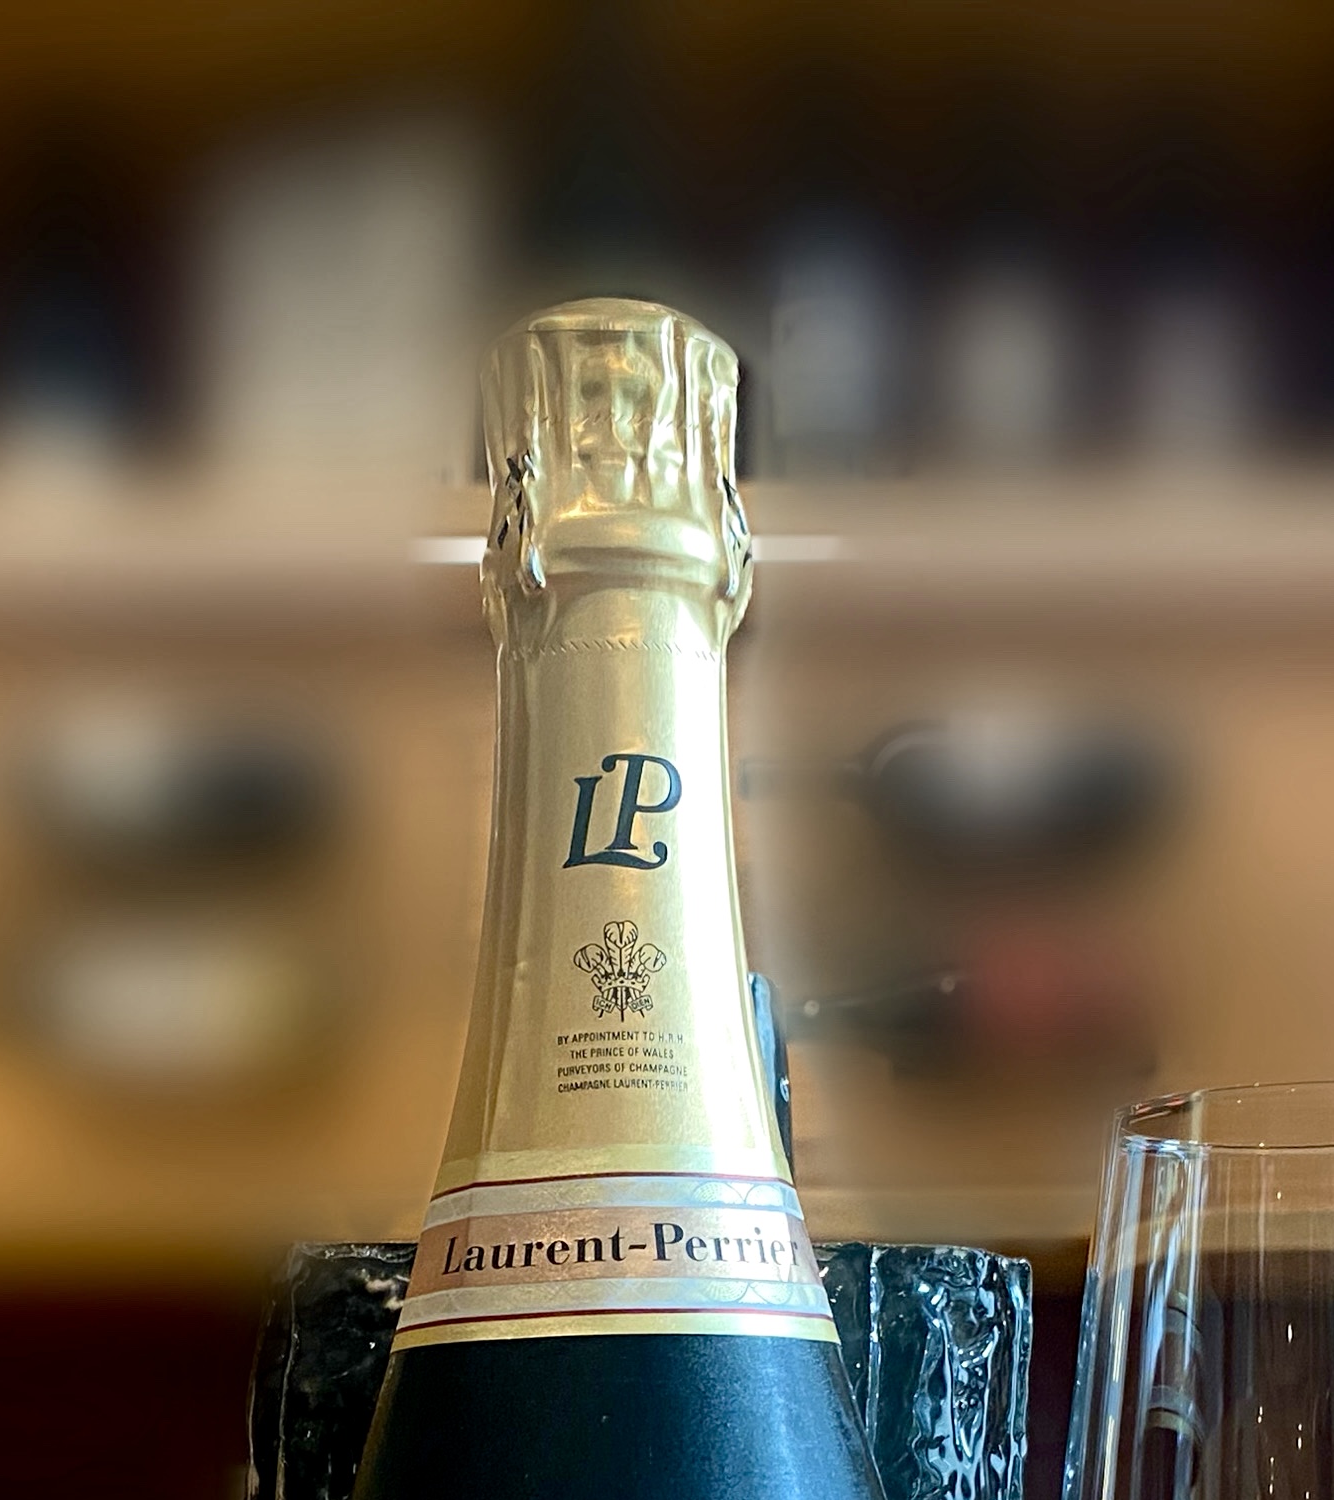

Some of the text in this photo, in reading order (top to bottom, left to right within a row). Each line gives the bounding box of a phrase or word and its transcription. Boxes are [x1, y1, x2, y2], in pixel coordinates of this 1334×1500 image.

[557, 1036, 569, 1046] BY
[571, 1031, 639, 1043] APPOINTMENT
[643, 1031, 655, 1042] TO
[570, 1046, 674, 1060] THE PRINCE OF WALES
[557, 1062, 688, 1078] PURVEYORS OF CHAMPAGNE
[558, 1078, 688, 1093] CHAMPAGNE LAURENT-PERRIER
[441, 1222, 801, 1277] Laurent-Perrier
